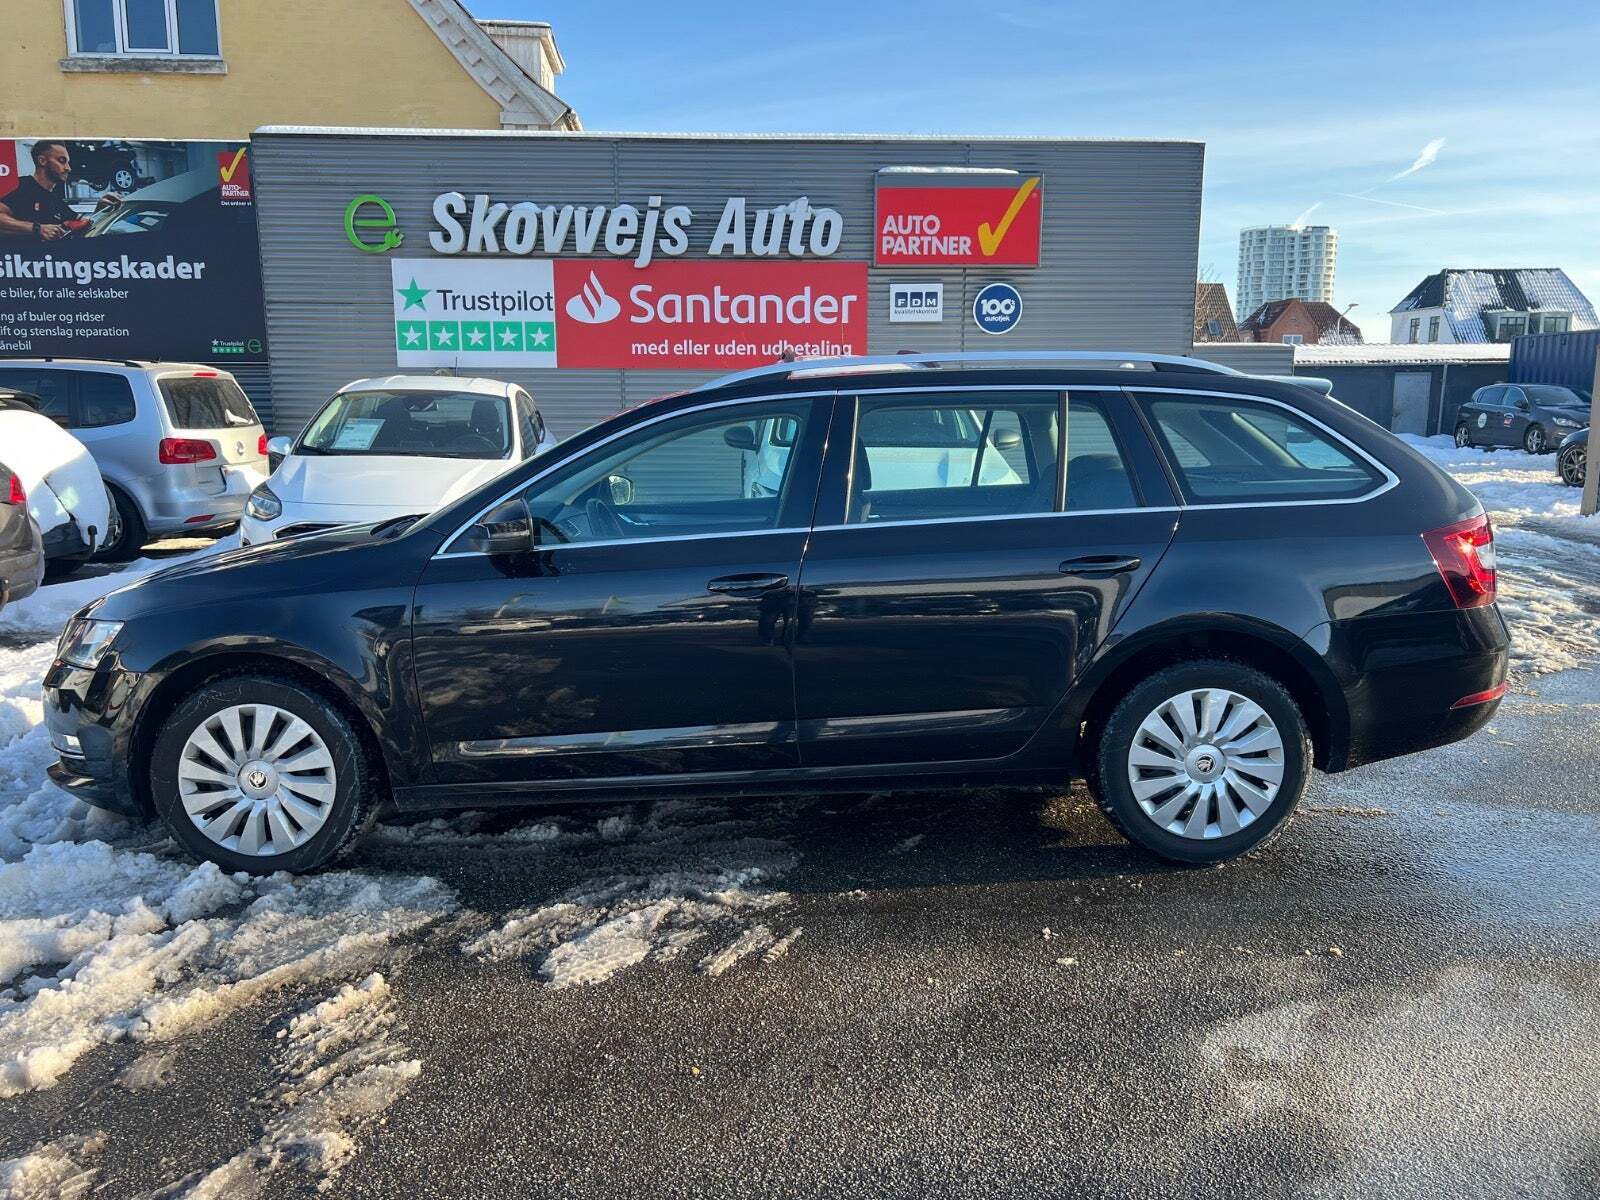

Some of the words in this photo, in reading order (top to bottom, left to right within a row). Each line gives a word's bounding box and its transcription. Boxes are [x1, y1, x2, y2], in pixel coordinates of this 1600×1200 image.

[429, 191, 693, 268] Skovvejs
[707, 197, 843, 256] Auto
[882, 214, 941, 235] AUTO
[882, 236, 972, 255] PARTNER
[9, 288, 36, 299] biler,
[38, 288, 54, 298] for
[56, 288, 76, 298] alle
[77, 288, 129, 299] selskaber
[897, 297, 937, 307] FDM
[436, 289, 554, 317] Trustpilot
[630, 284, 858, 325] Santander
[17, 311, 28, 321] af
[29, 312, 57, 322] buler
[59, 315, 73, 324] og
[75, 312, 105, 322] ridser
[13, 328, 28, 338] og
[29, 326, 73, 339] stenslag
[75, 327, 130, 338] reparation
[631, 340, 669, 355] med
[673, 339, 710, 355] eller
[714, 341, 757, 355] uden
[761, 339, 853, 356] udbetaling
